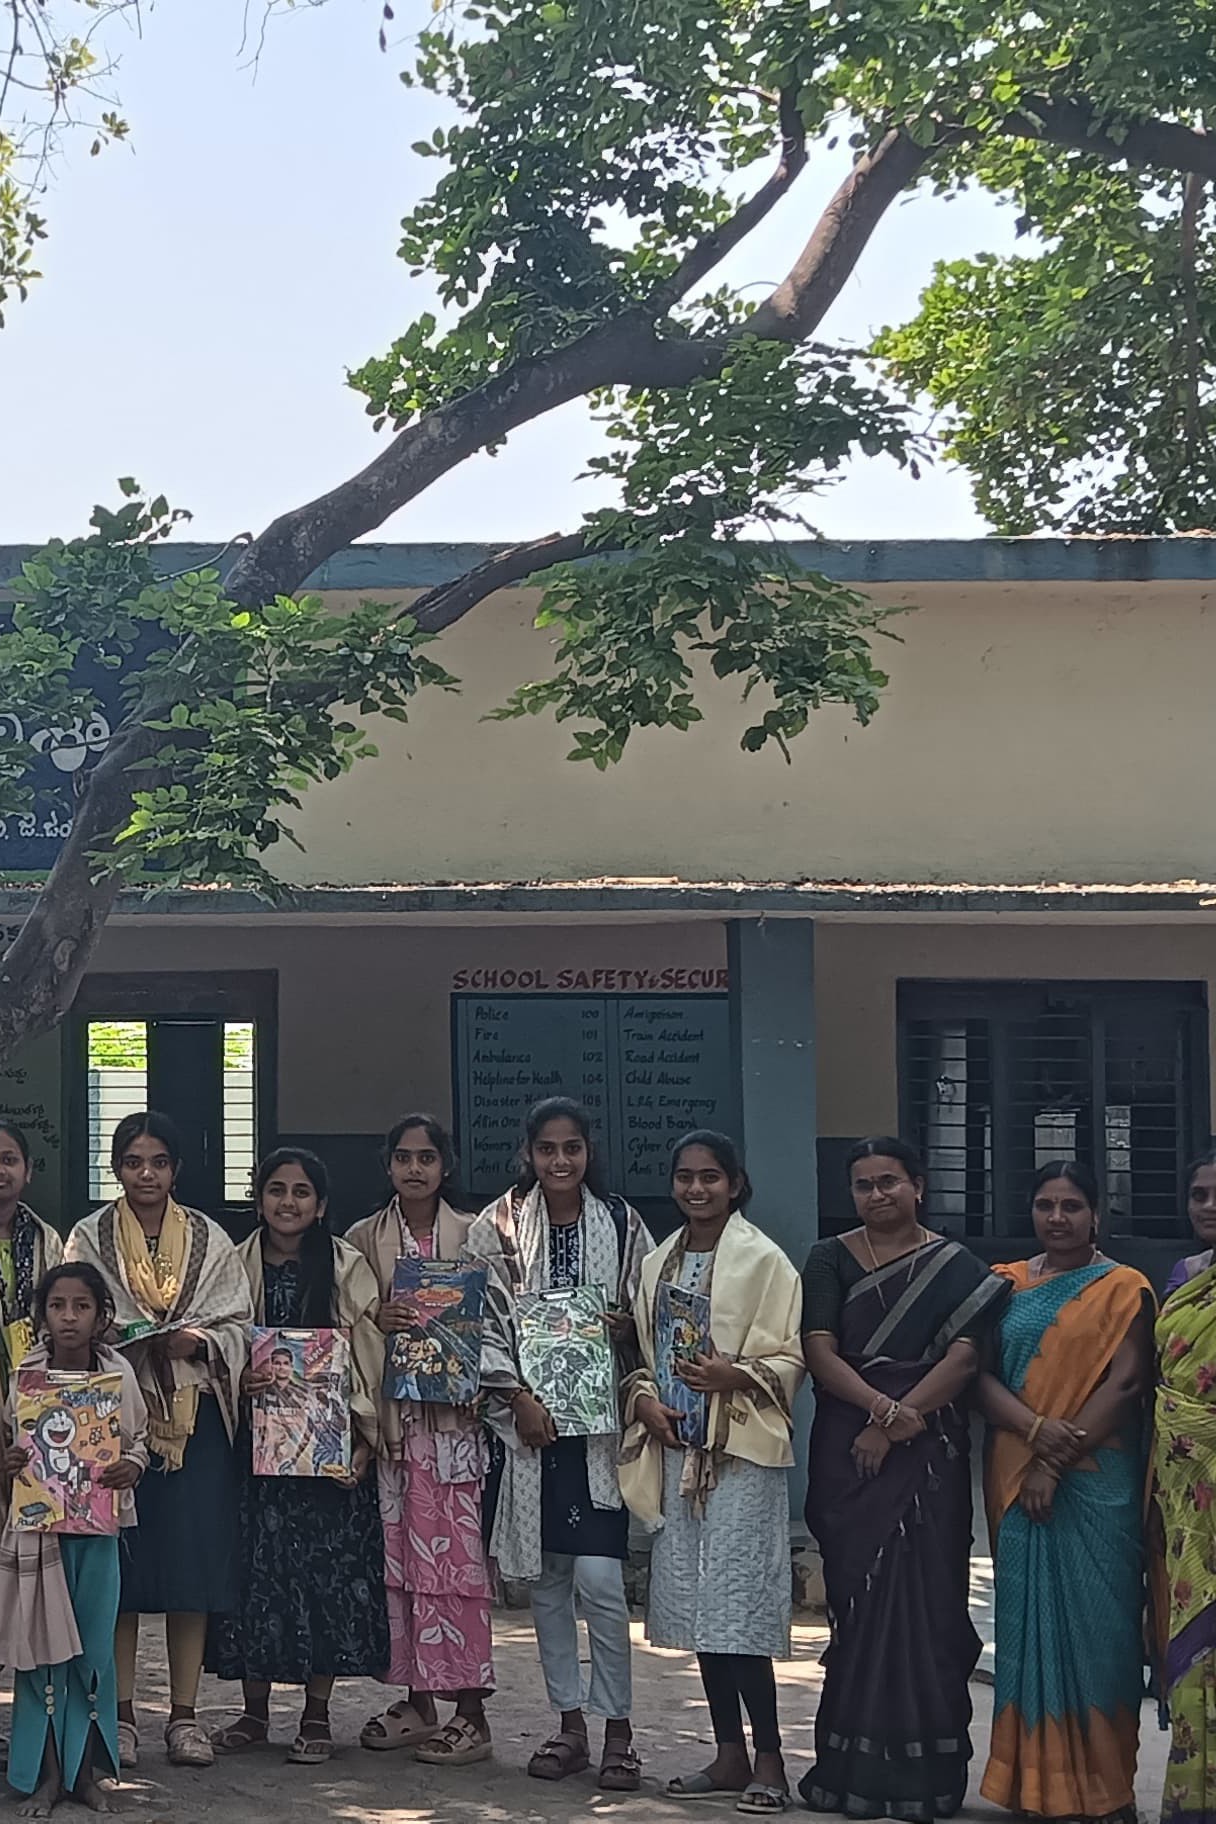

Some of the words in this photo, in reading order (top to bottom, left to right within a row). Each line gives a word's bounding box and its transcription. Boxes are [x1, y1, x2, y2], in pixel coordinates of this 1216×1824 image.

[452, 969, 549, 990] SCHOOL
[556, 968, 649, 990] SAFETY
[474, 1005, 510, 1021] Police
[580, 1009, 600, 1019] 100
[474, 1027, 500, 1041] Fire
[581, 1029, 599, 1041] 101
[658, 1028, 704, 1042] Accident
[472, 1050, 532, 1064] Ambulance
[582, 1051, 604, 1063] 102
[625, 1049, 655, 1064] Road
[657, 1049, 700, 1064] Accident
[625, 1070, 653, 1085] Child
[656, 1071, 692, 1086] Abuse
[474, 1095, 522, 1108] Disaster
[659, 1095, 717, 1115] Emergency
[628, 1115, 662, 1130] Blood
[666, 1114, 698, 1130] Bank
[627, 1136, 662, 1159] Cyber
